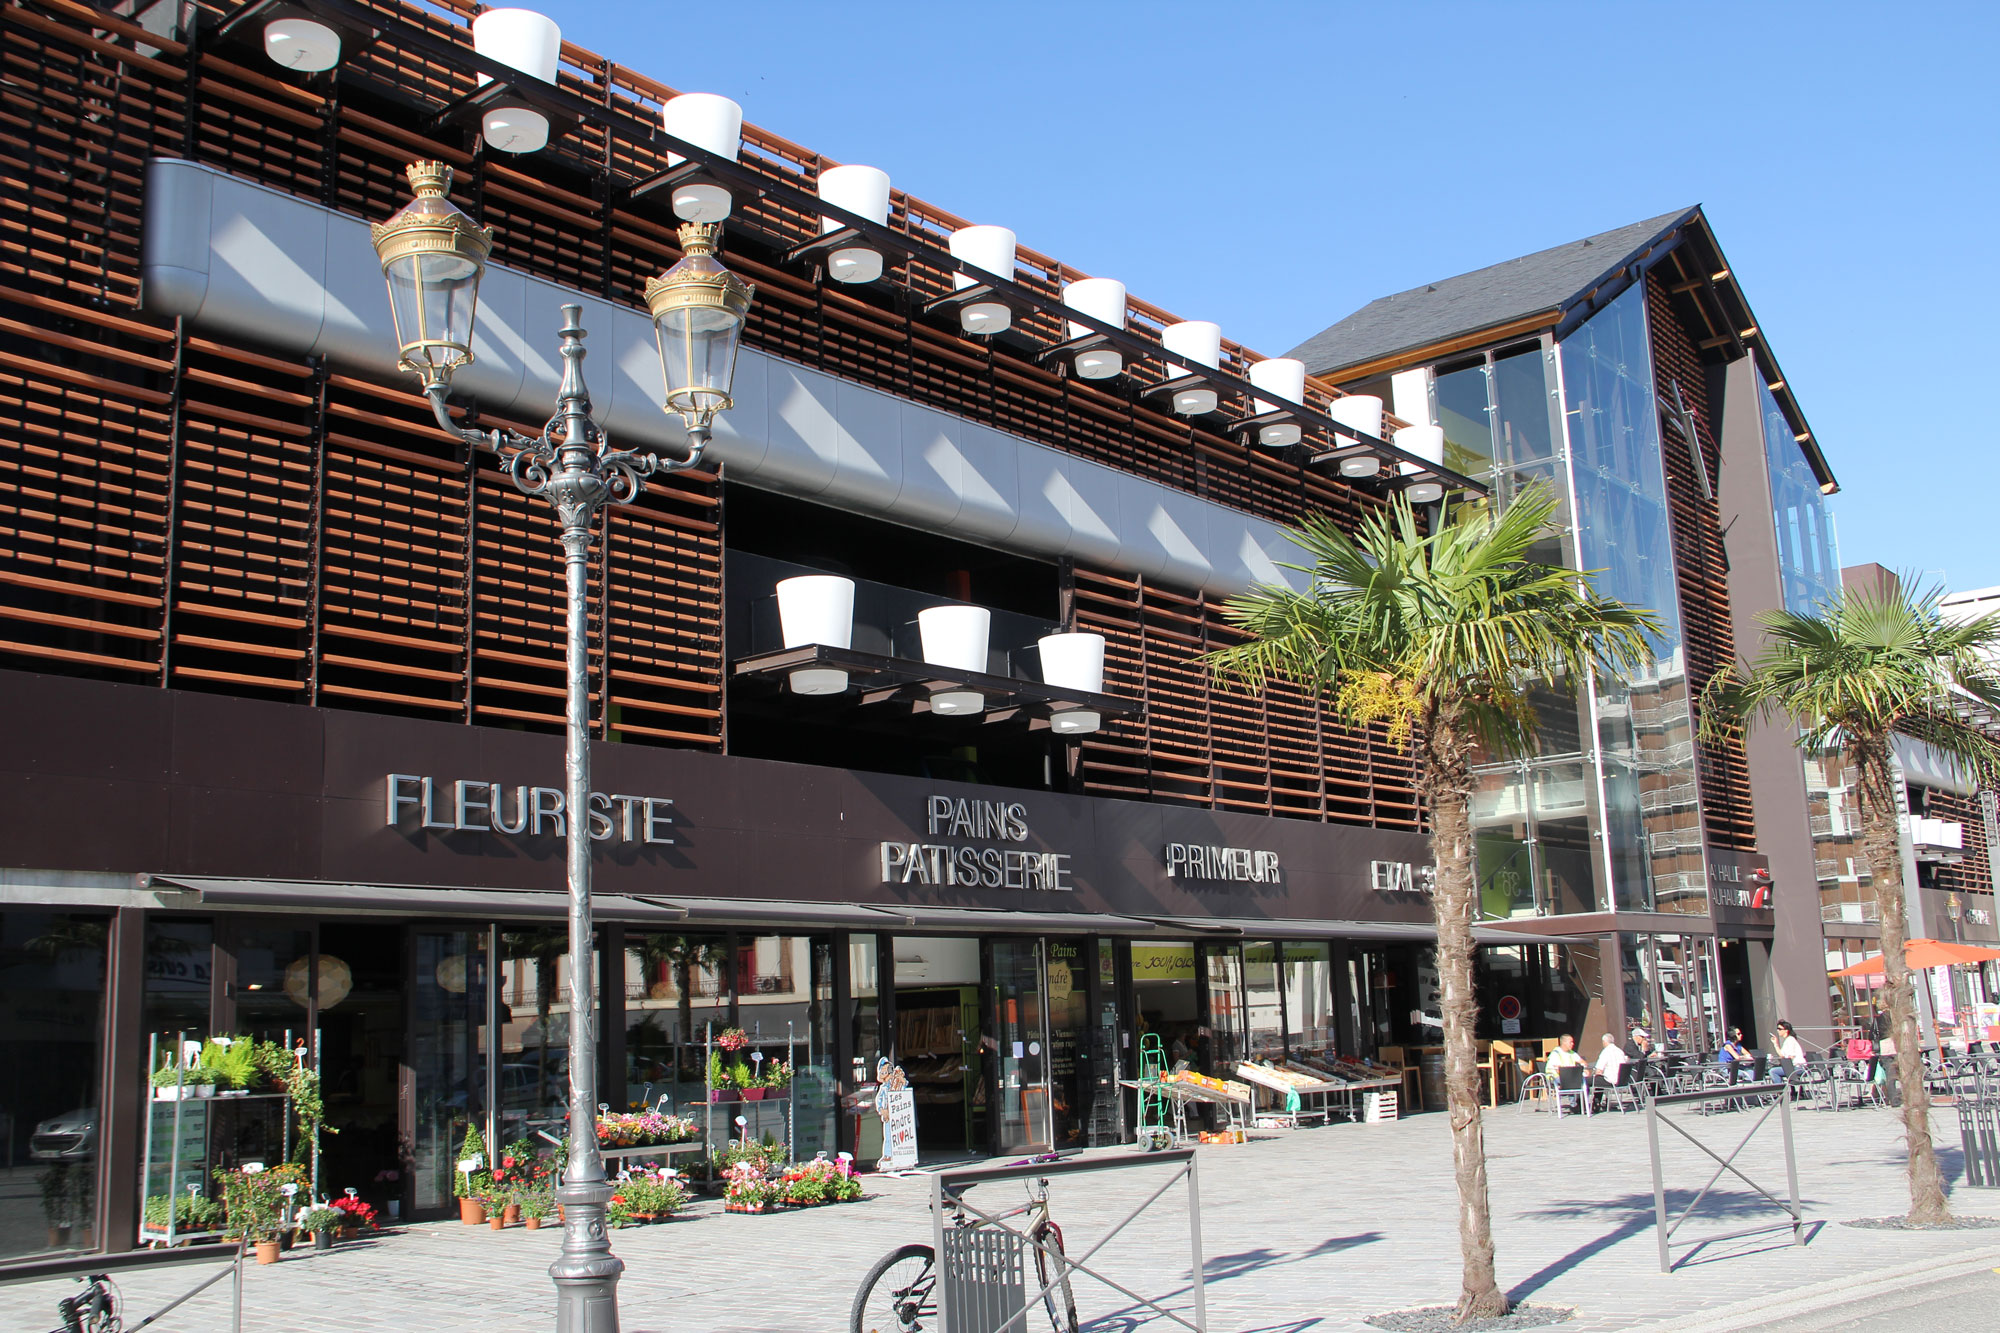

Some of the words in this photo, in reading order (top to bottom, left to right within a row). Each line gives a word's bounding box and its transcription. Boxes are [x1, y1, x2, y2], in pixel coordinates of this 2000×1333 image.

[386, 773, 675, 845] FLEURSTE
[928, 795, 1029, 842] PAINS
[880, 841, 1073, 891] PATISSERIE
[1166, 843, 1281, 884] PRIMEUR
[1371, 860, 1421, 892] ETAL
[1050, 942, 1078, 958] Pains
[1048, 969, 1068, 984] ndré
[889, 1092, 903, 1103] Les
[891, 1100, 912, 1114] Pains
[890, 1110, 912, 1132] André
